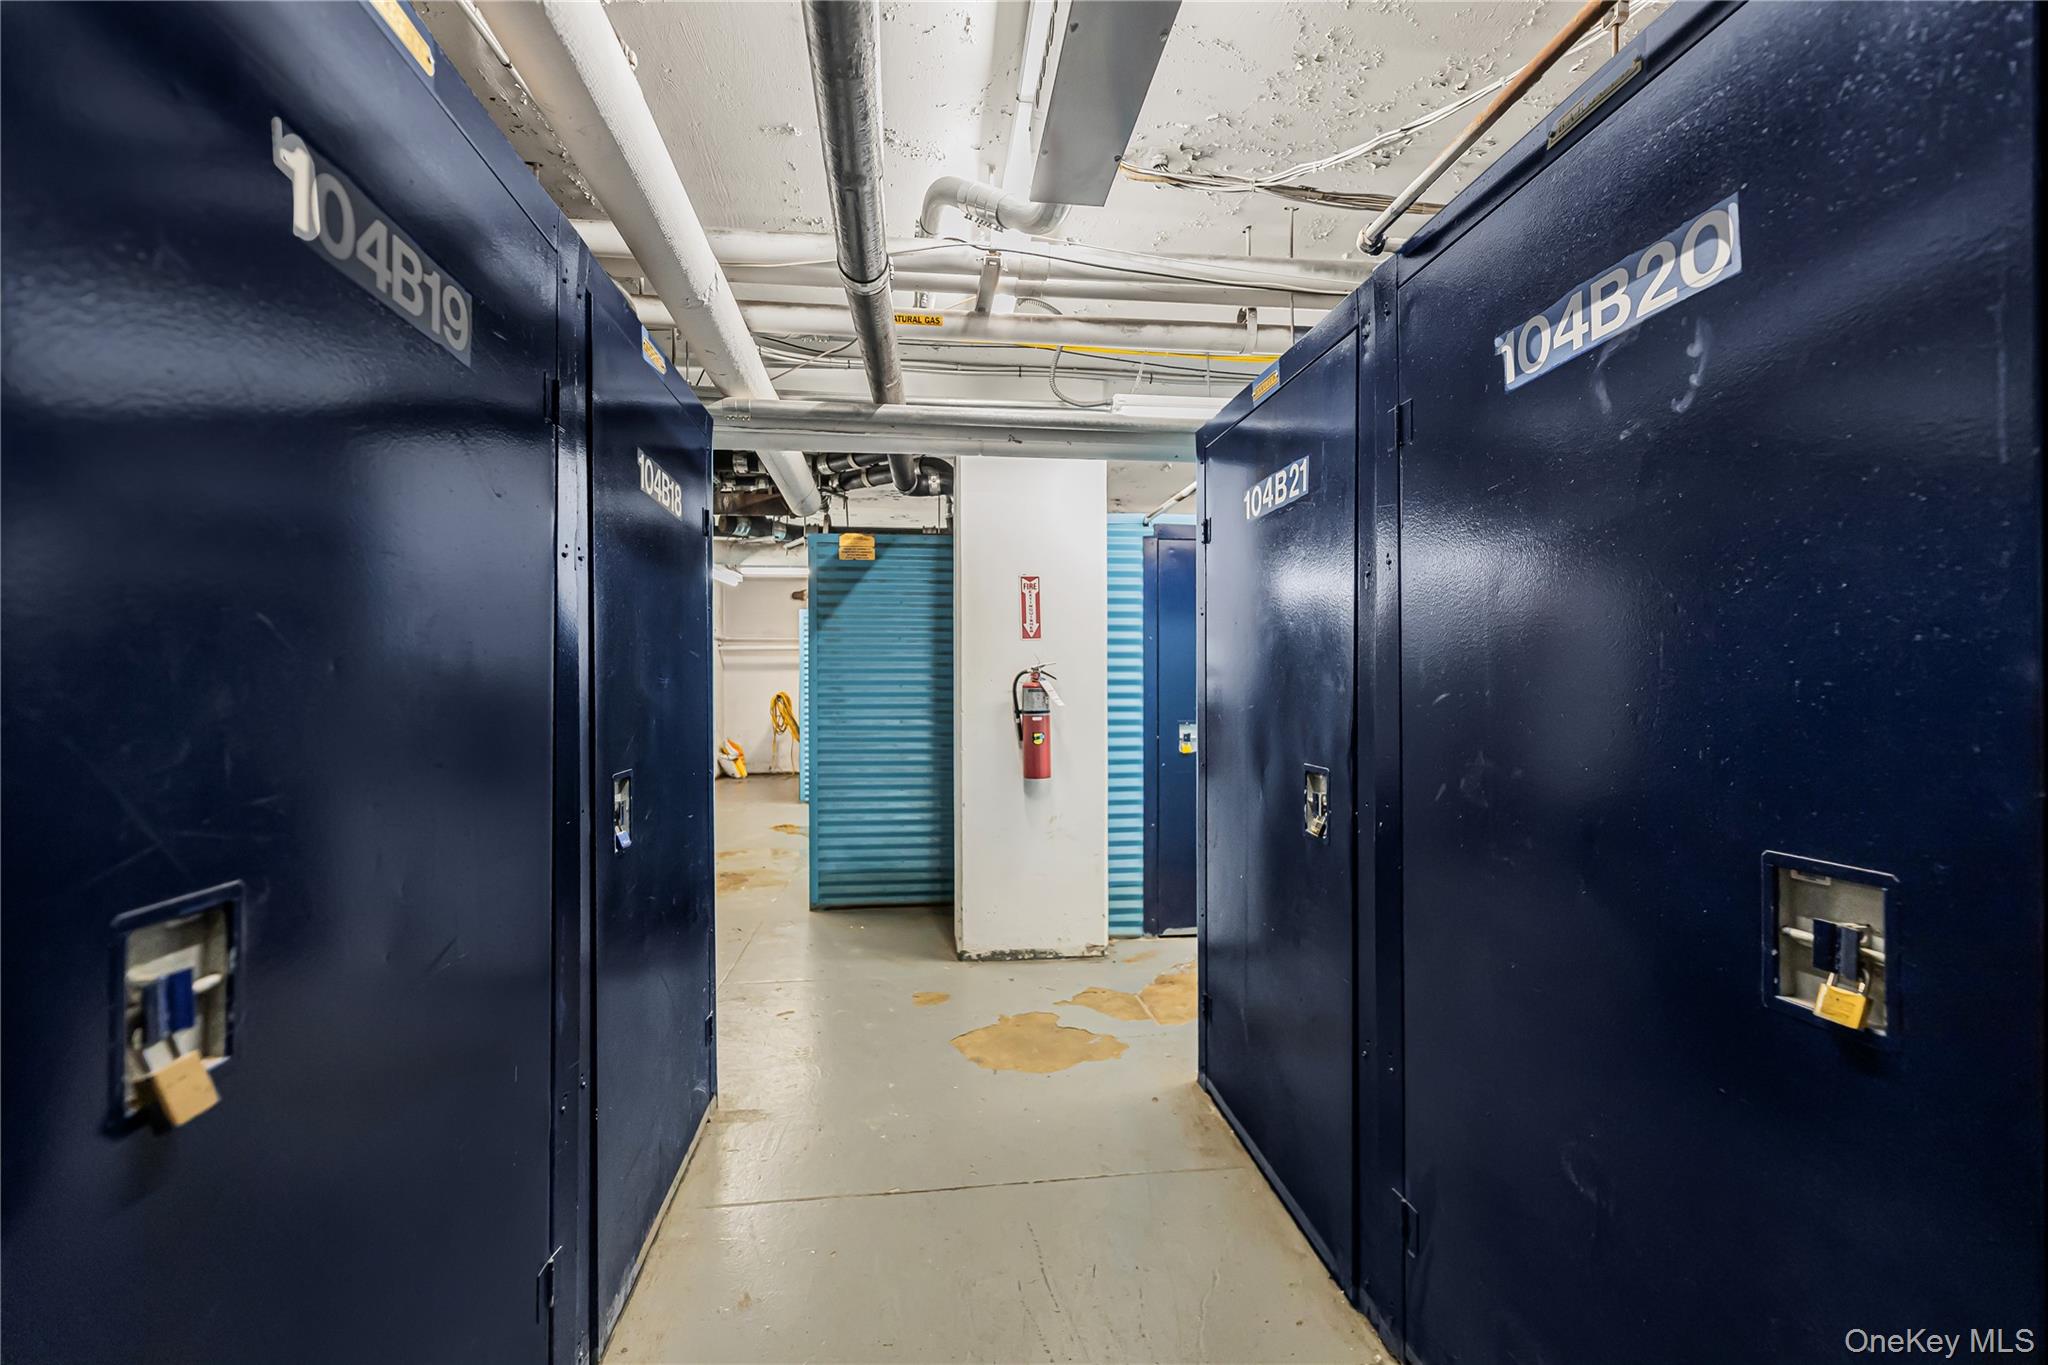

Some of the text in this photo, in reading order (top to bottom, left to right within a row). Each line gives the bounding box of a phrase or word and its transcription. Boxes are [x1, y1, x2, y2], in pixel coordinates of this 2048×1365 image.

[277, 139, 469, 351] 104B19
[925, 316, 941, 324] GAS
[1500, 209, 1734, 385] 104B20
[638, 453, 682, 517] 104B18
[1243, 458, 1307, 520] 104B21
[1023, 582, 1037, 590] FIRE
